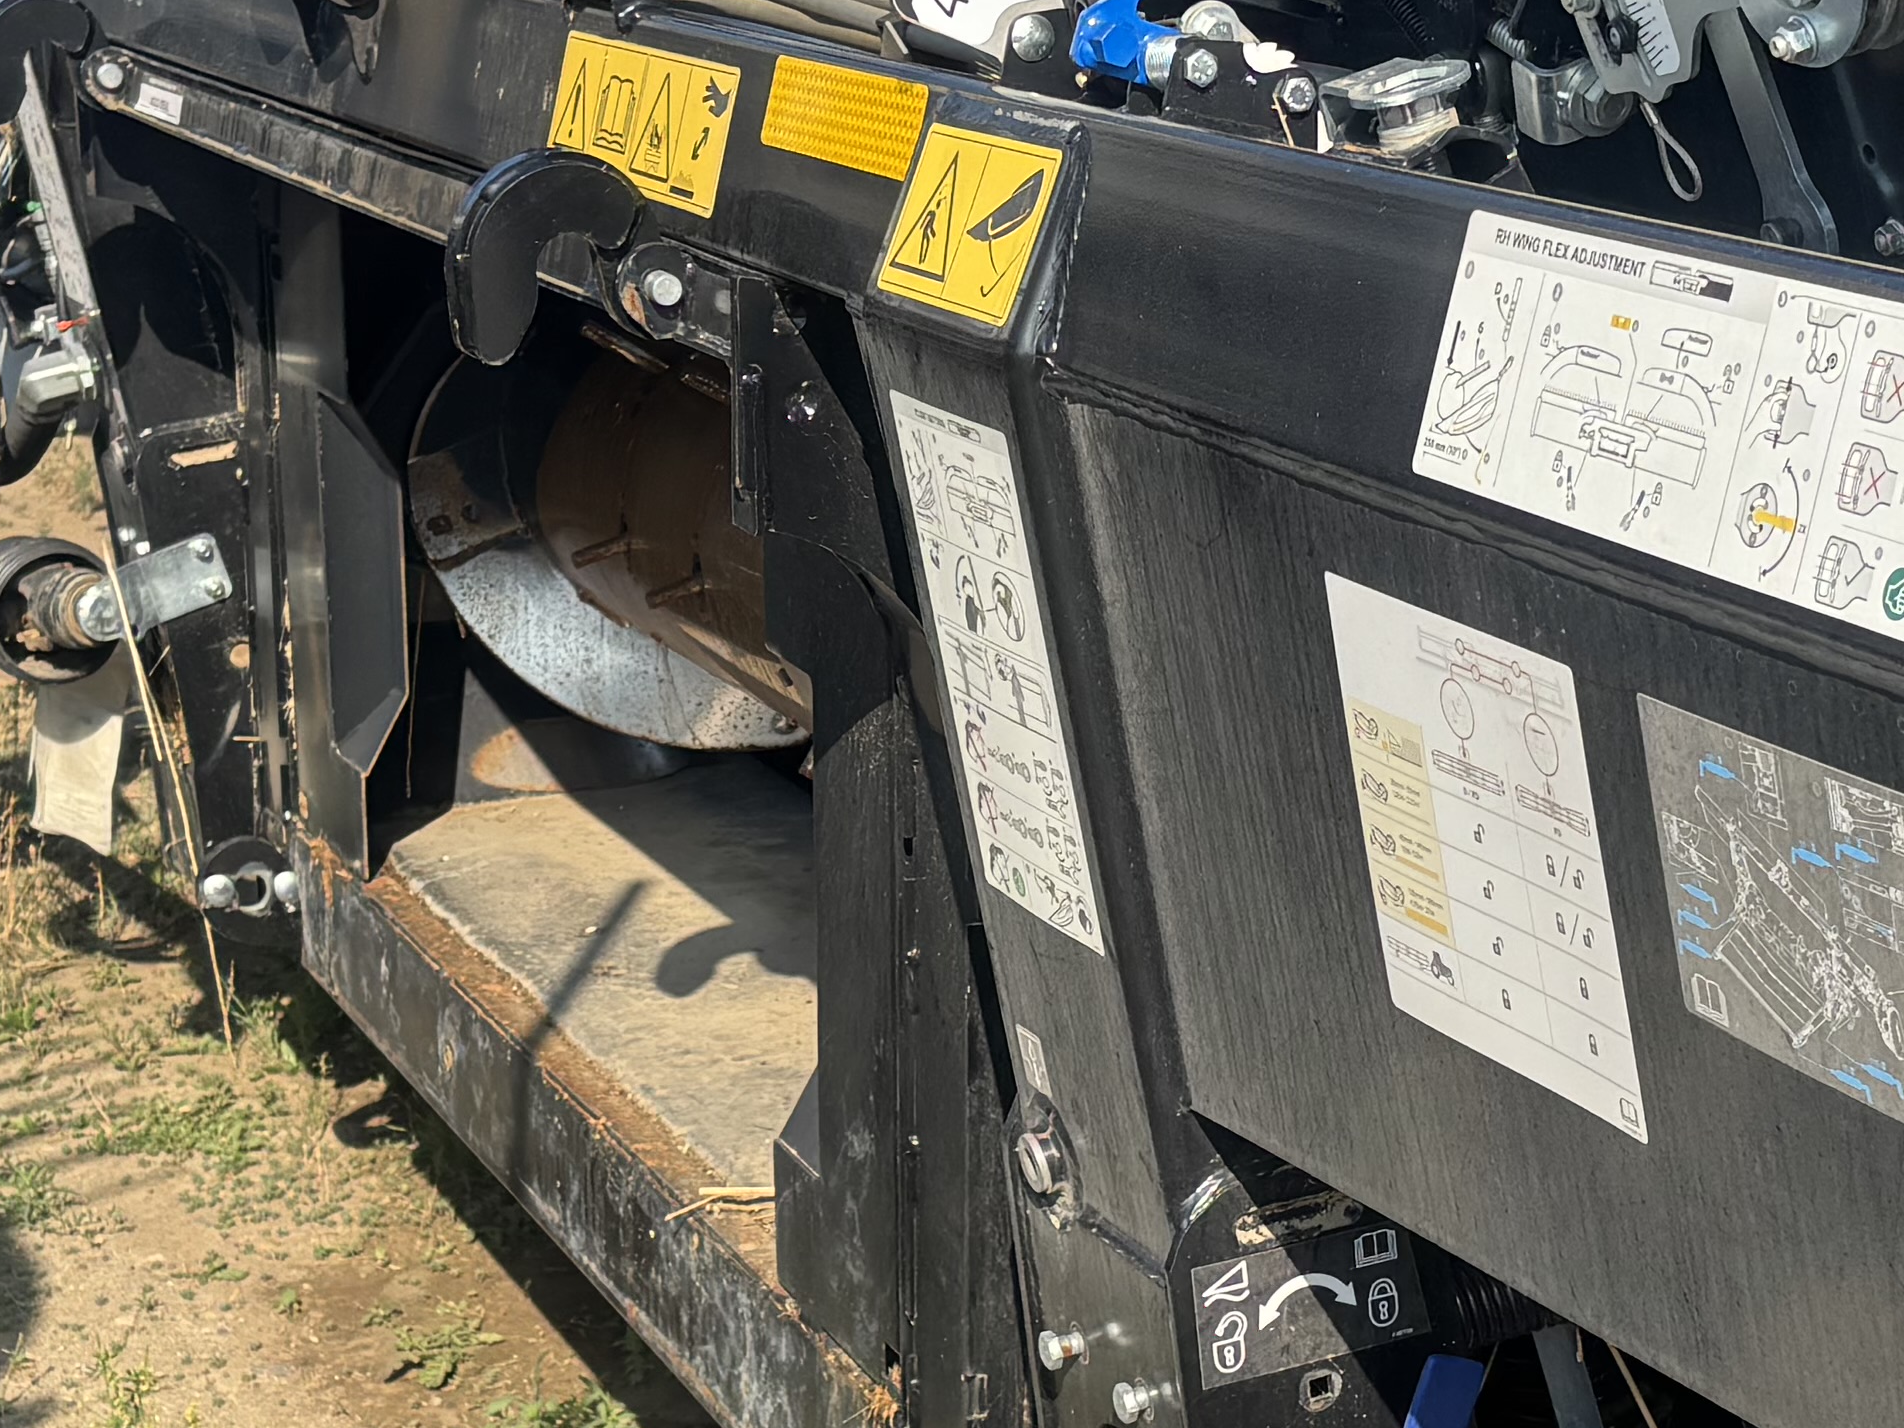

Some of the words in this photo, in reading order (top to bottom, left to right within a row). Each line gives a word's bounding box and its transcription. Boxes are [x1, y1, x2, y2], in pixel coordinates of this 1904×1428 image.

[1511, 231, 1541, 254] WING
[1542, 240, 1570, 262] FLEX
[1569, 245, 1647, 279] ADJUSTMENT
